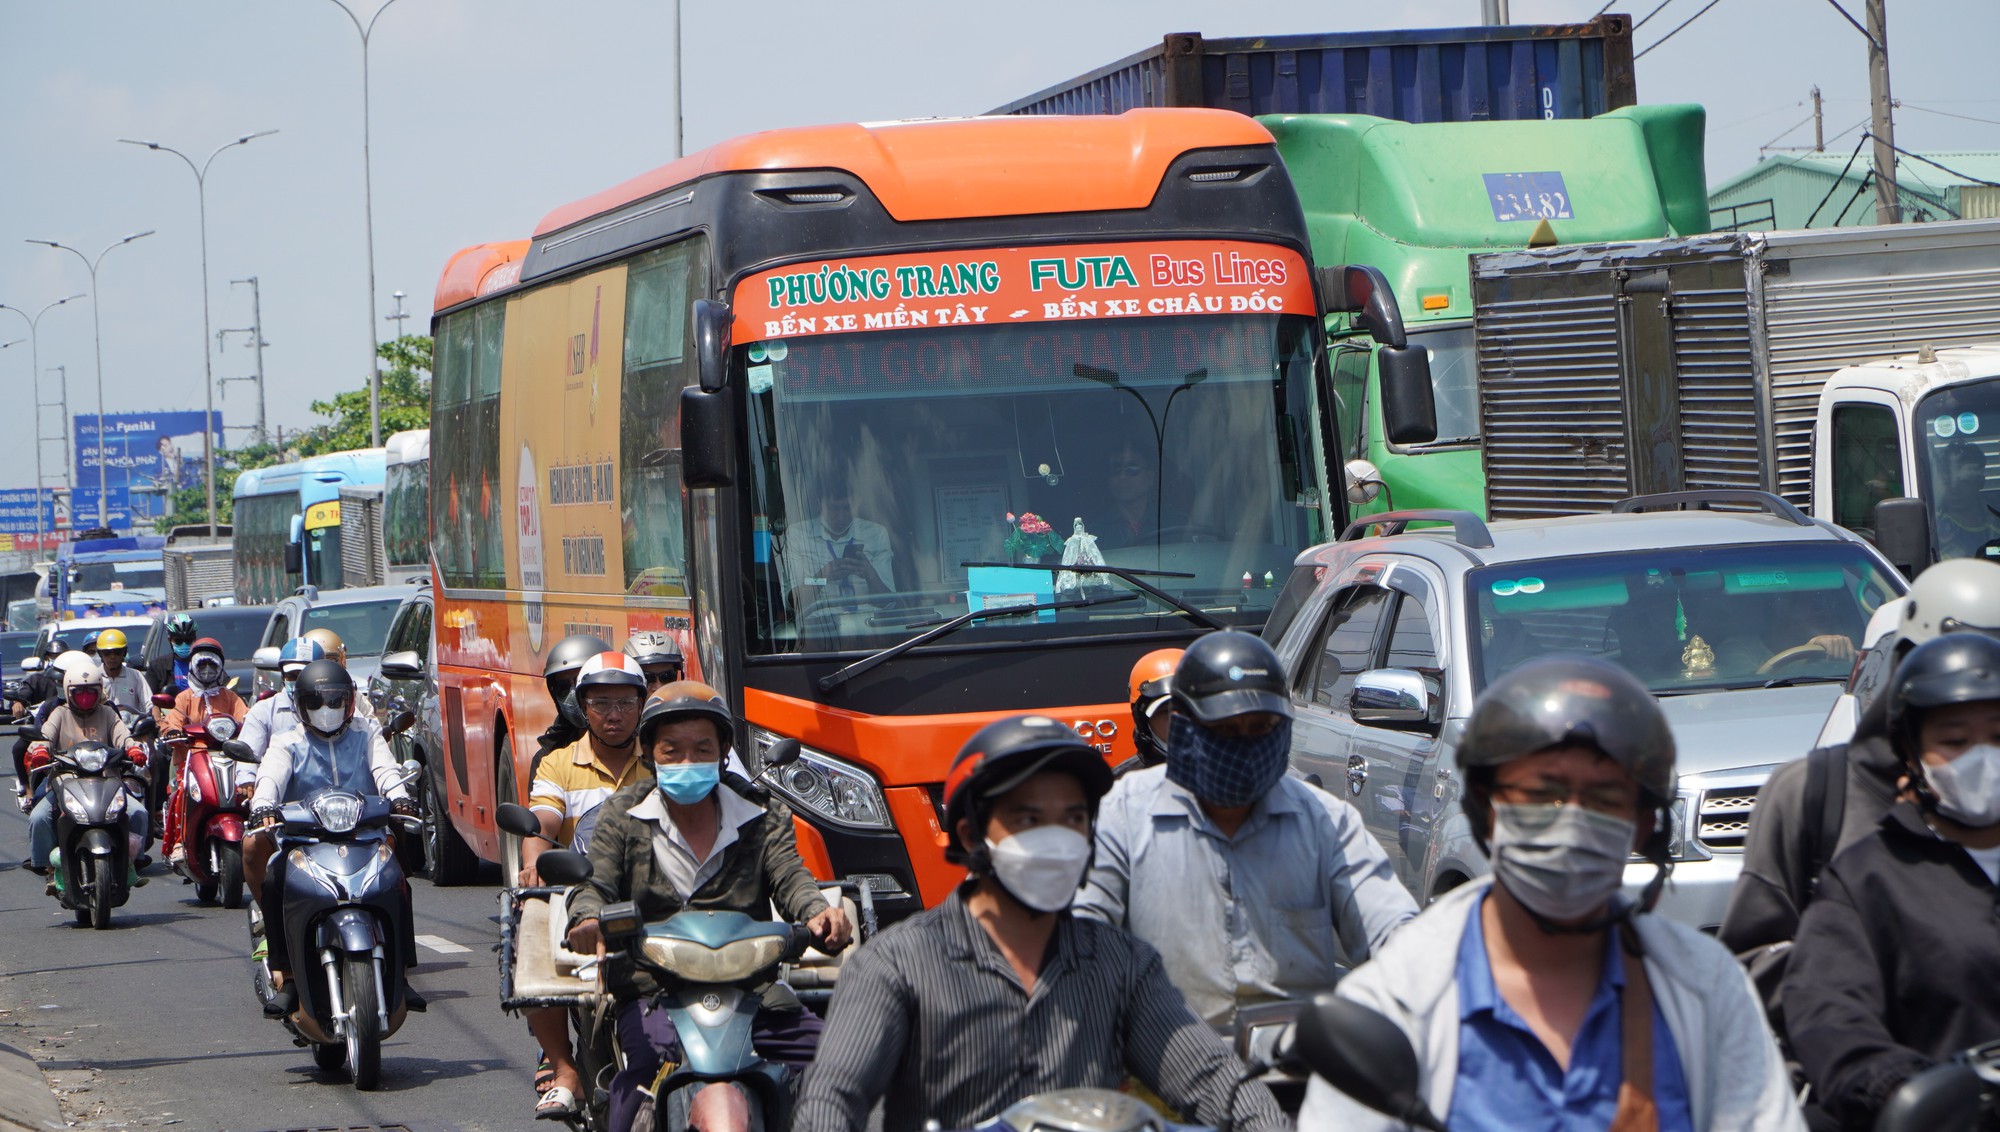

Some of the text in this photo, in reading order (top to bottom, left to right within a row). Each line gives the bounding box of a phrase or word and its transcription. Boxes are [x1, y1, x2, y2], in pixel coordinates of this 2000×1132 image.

[767, 261, 1000, 308] PHƯƠNG TRANG
[1029, 252, 1287, 292] FUTA Bus Lines
[765, 303, 988, 337] BẾN XE MIỀN TÂY
[1043, 288, 1283, 319] BẾN XE CHÂU ĐỐC
[116, 420, 156, 433] Funiki
